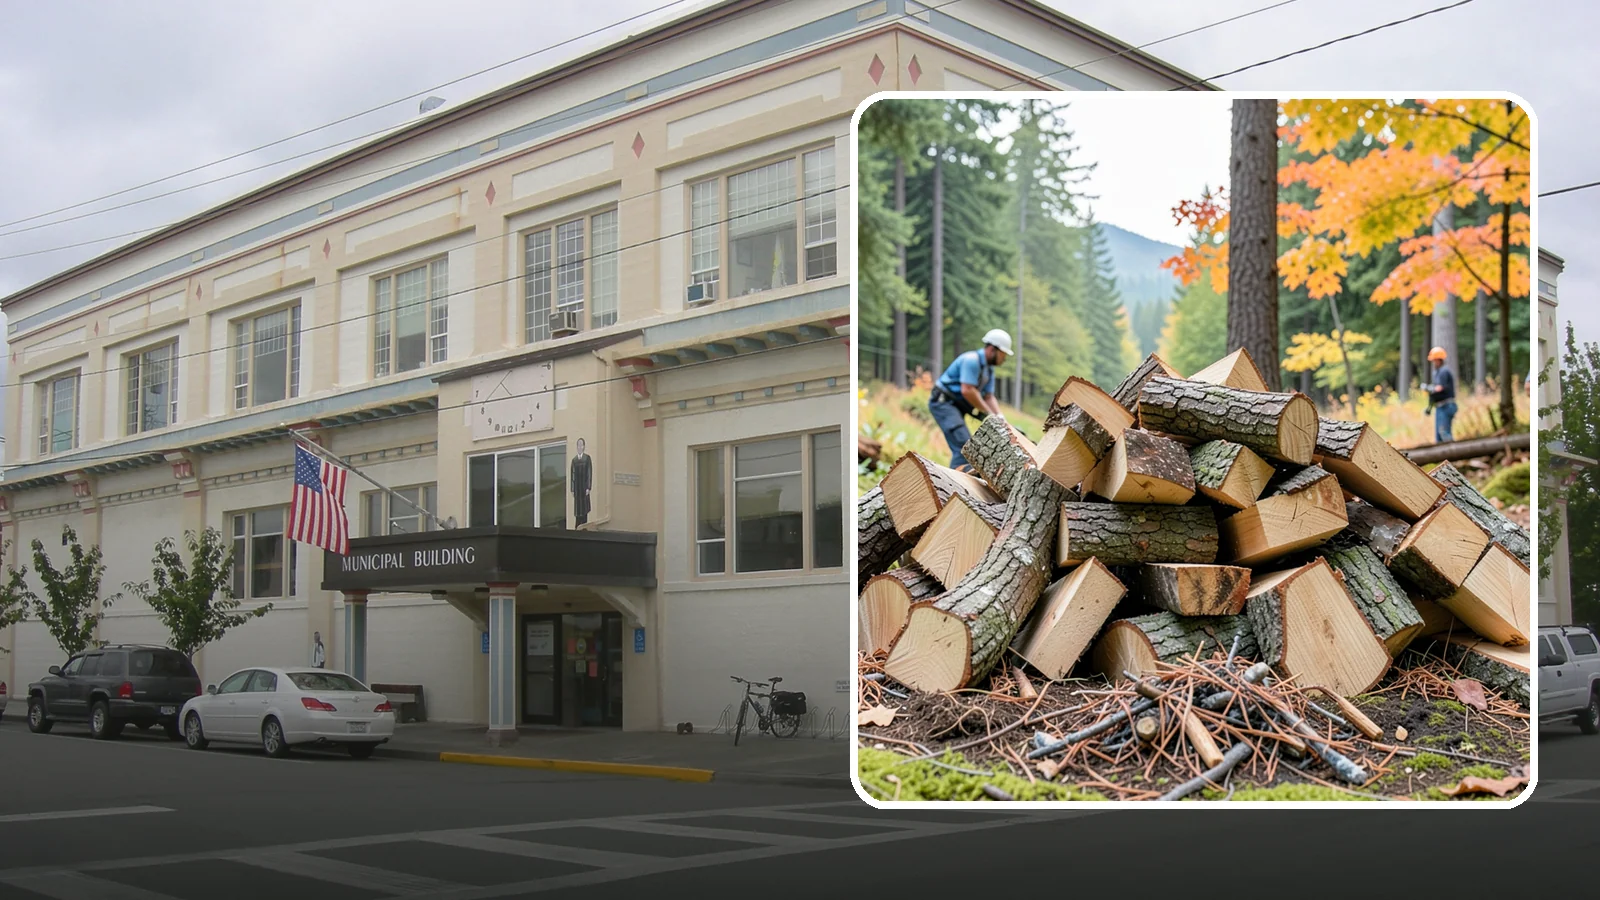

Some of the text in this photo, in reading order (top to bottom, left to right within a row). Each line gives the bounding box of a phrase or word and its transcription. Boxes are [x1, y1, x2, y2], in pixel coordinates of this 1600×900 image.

[507, 425, 514, 433] 12
[342, 546, 475, 572] MUNICIPAL BUILDING
